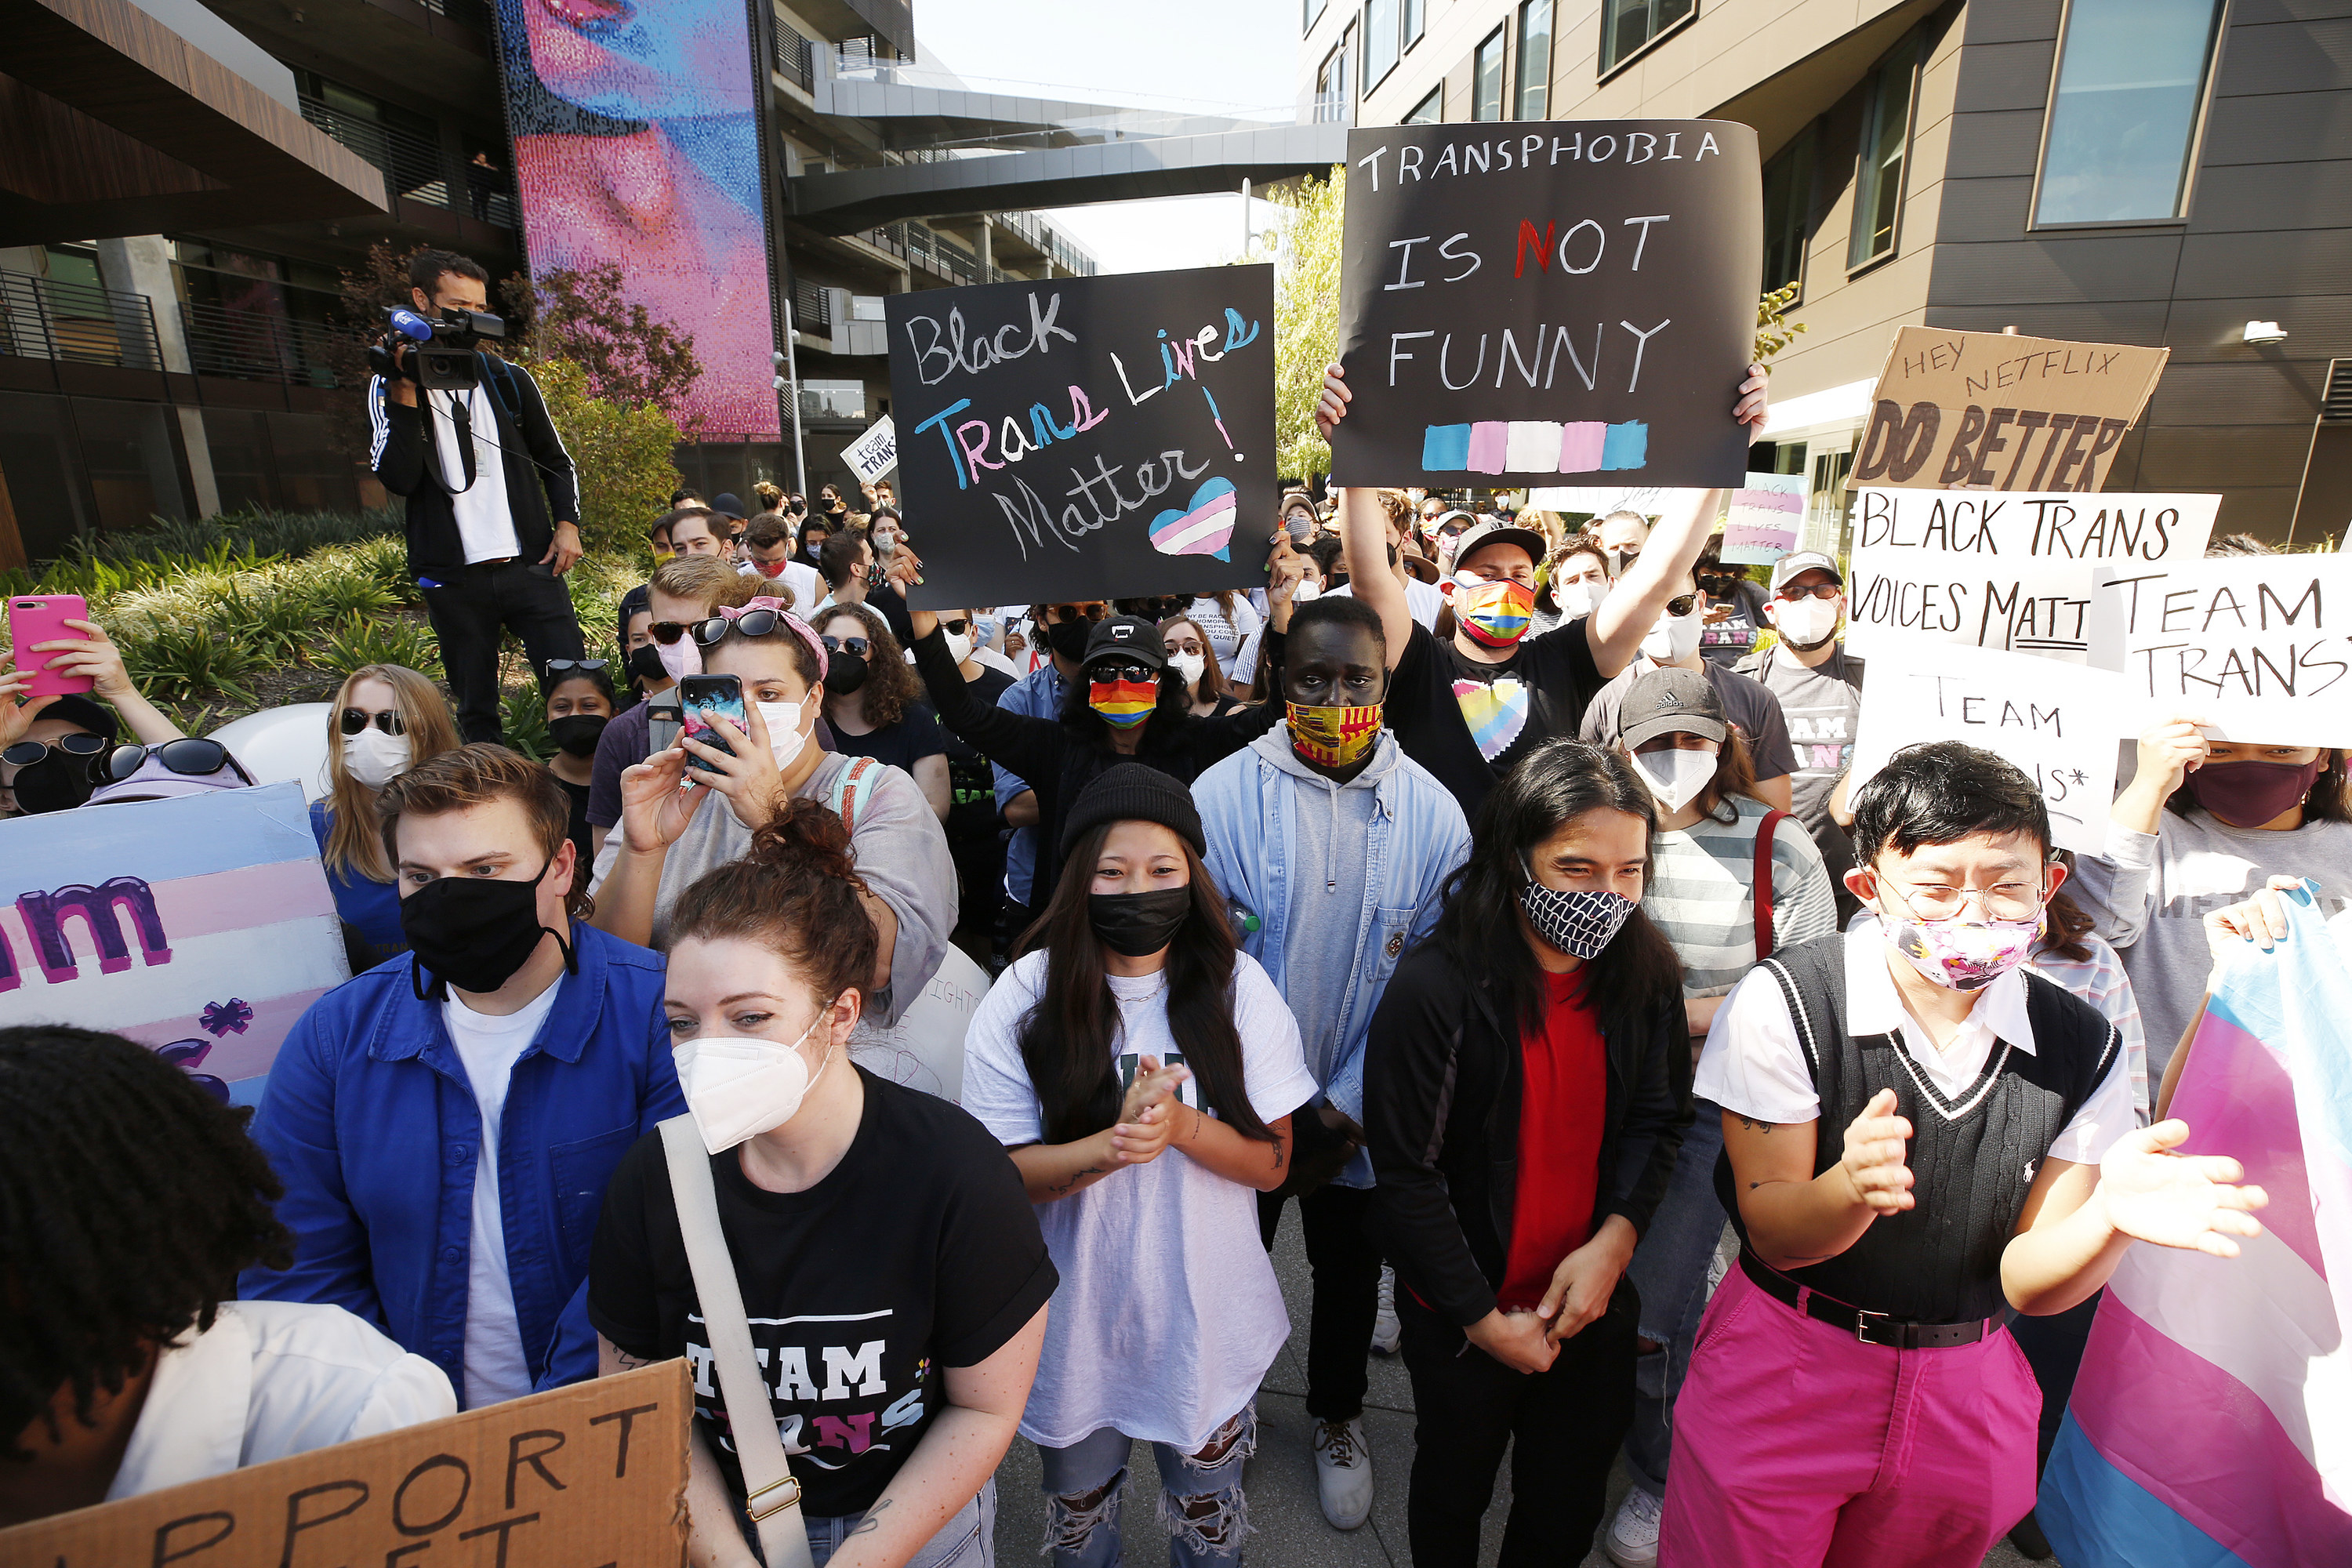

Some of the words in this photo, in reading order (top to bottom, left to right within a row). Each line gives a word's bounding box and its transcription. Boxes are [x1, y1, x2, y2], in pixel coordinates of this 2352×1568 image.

[1358, 132, 1721, 192] TRANSPHOBIA
[1383, 232, 1482, 291] IS
[1514, 214, 1671, 278] NOT
[905, 291, 1077, 386] Black
[1109, 307, 1261, 406] Lives
[1388, 318, 1671, 393] FUNNY
[1904, 336, 1966, 379] HEY
[1965, 350, 2121, 397] NETFLIX
[857, 433, 887, 459] team
[1855, 399, 1942, 482] DO
[1937, 405, 2129, 492] BETTER
[991, 448, 1210, 562] Matter
[1740, 503, 1785, 514] TRANS
[1744, 480, 1788, 499] BLACK
[1731, 541, 1784, 554] MATTER
[1737, 521, 1781, 532] LIVES
[1860, 492, 2007, 556] BLACK
[2023, 499, 2180, 561] TRANS
[1703, 619, 1750, 630] EAM
[1851, 570, 1967, 632] VOICES
[2101, 573, 2322, 634] TEAM
[1704, 631, 1757, 644] RANS
[1785, 717, 1848, 739] AM
[1909, 673, 2062, 739] TEAM
[0, 875, 173, 993] m
[686, 1339, 887, 1402] TAM
[55, 1402, 658, 1568] PPORT
